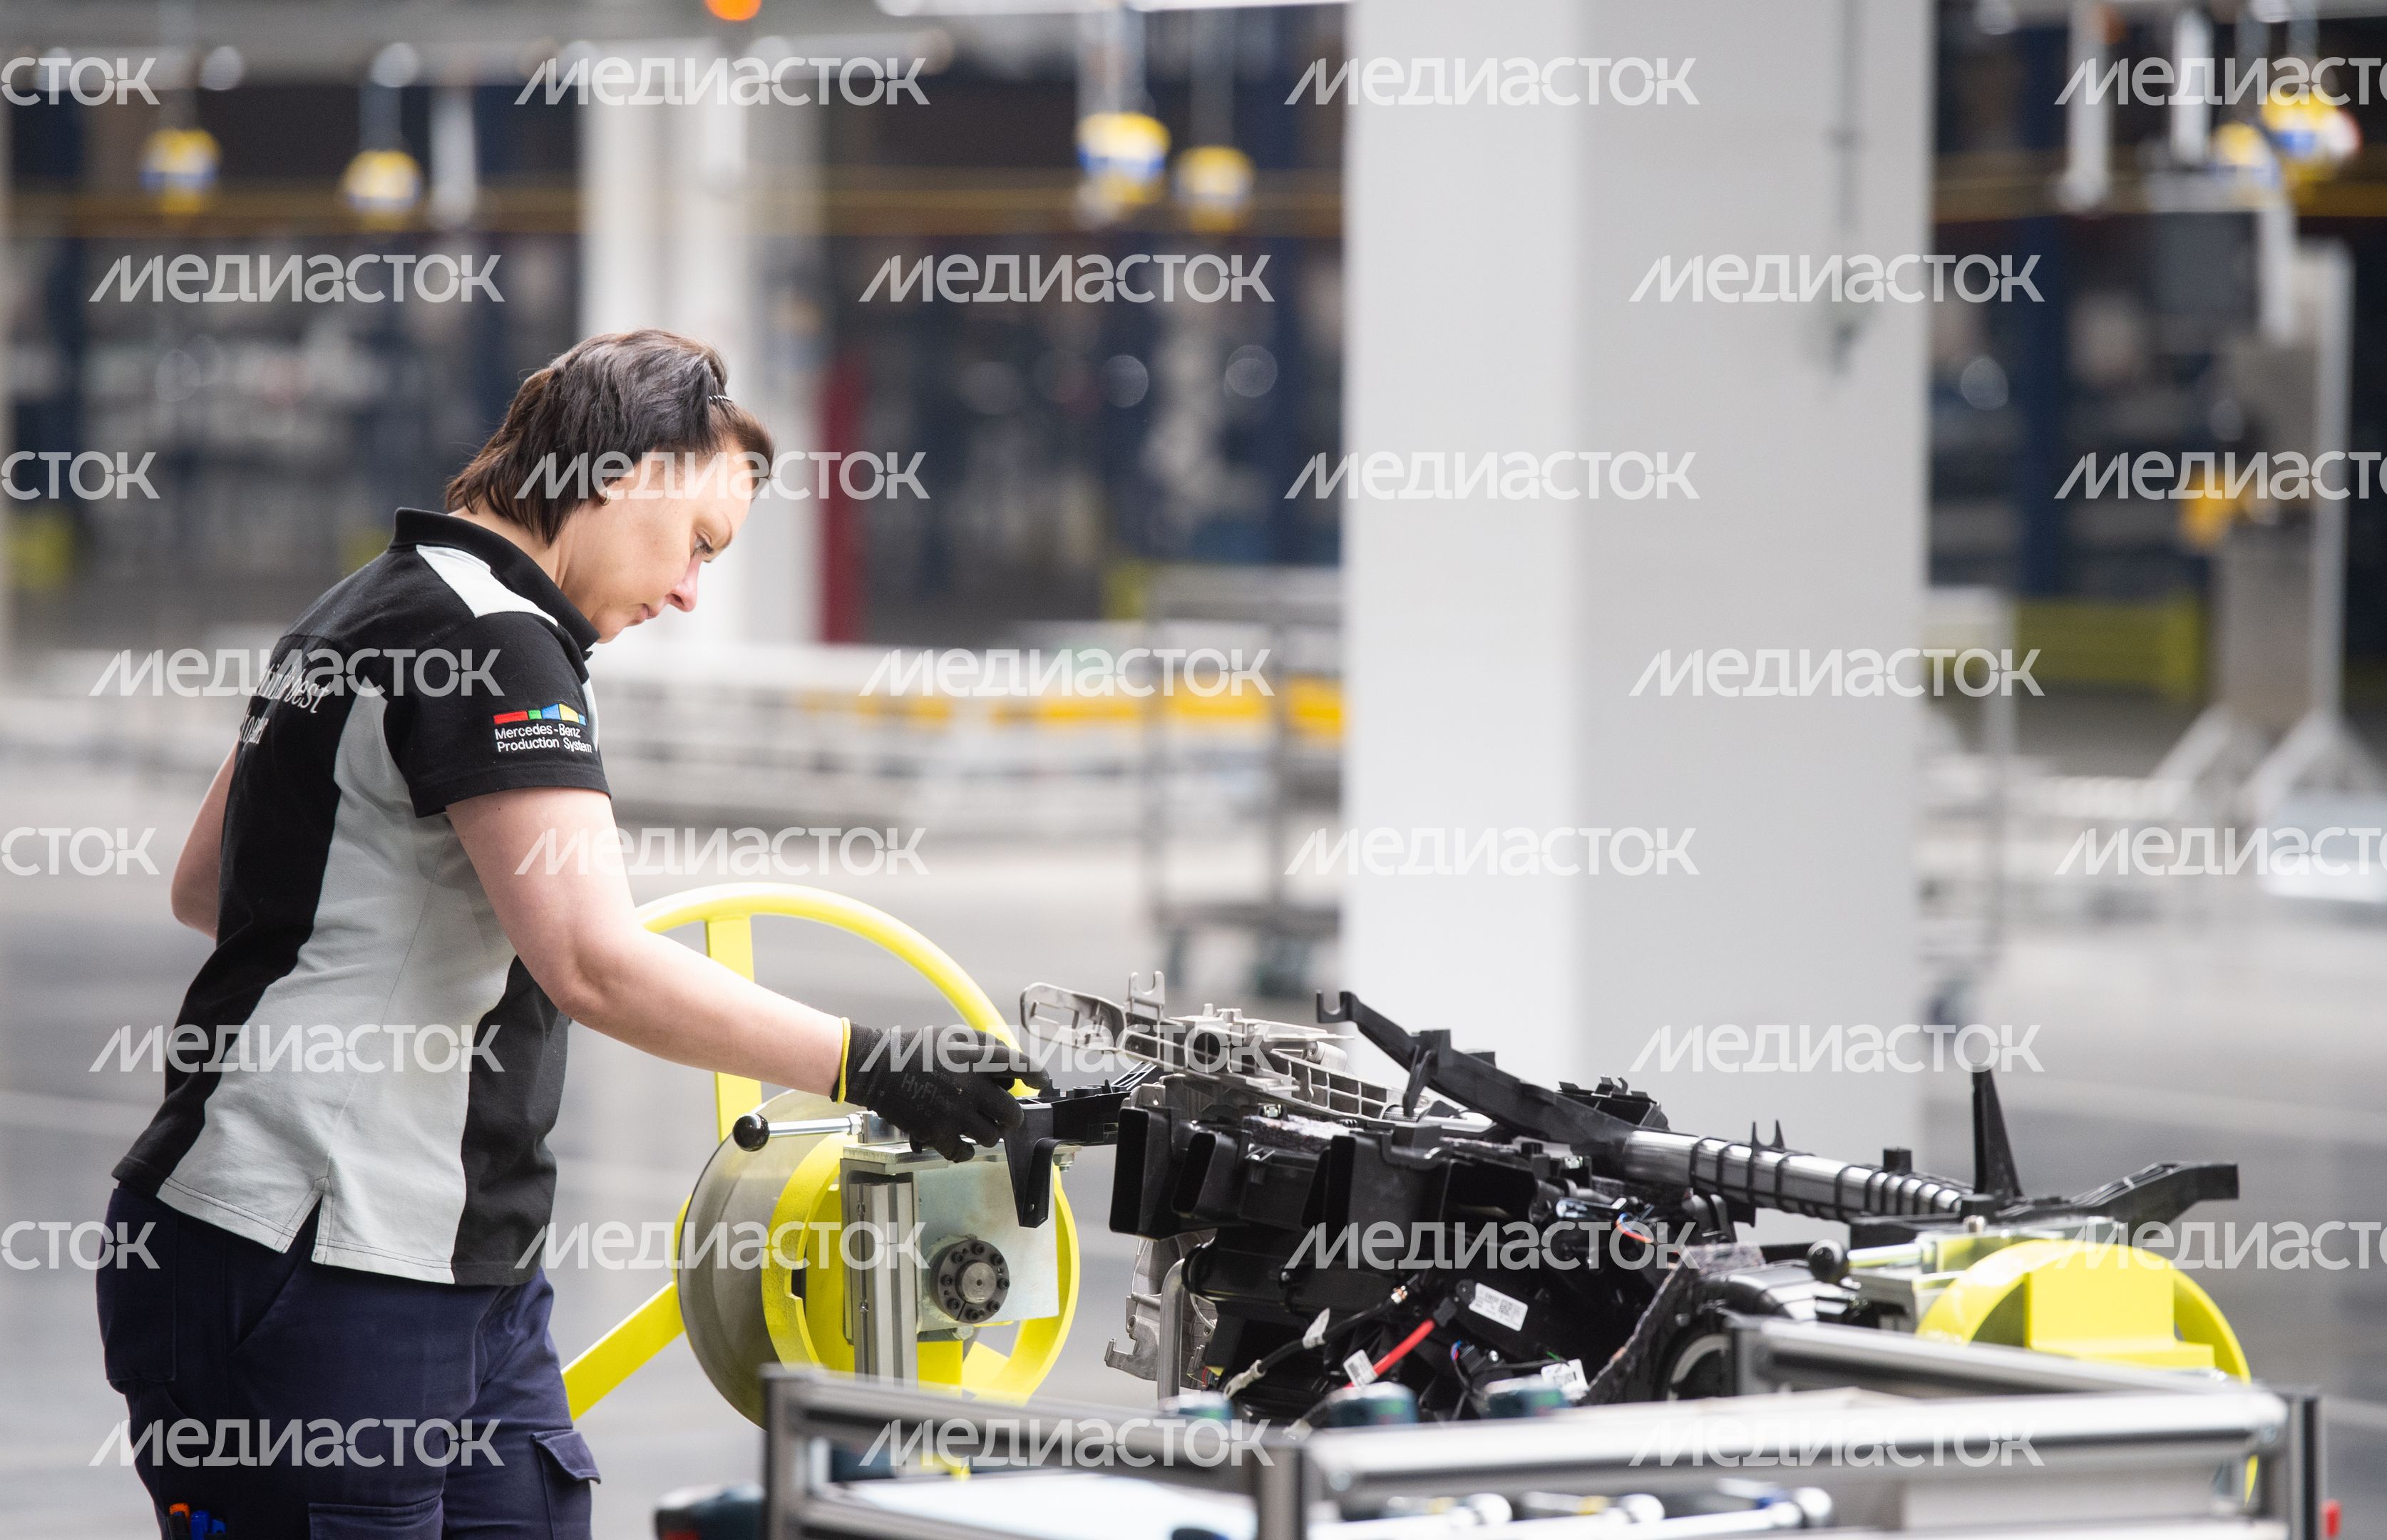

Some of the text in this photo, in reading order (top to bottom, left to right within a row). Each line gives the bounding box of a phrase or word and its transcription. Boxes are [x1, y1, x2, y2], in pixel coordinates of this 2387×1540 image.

[284, 669, 332, 714] best
[494, 723, 581, 740] Mercedes-Benz
[497, 736, 592, 753] Production System
[901, 1073, 954, 1109] HyFl
